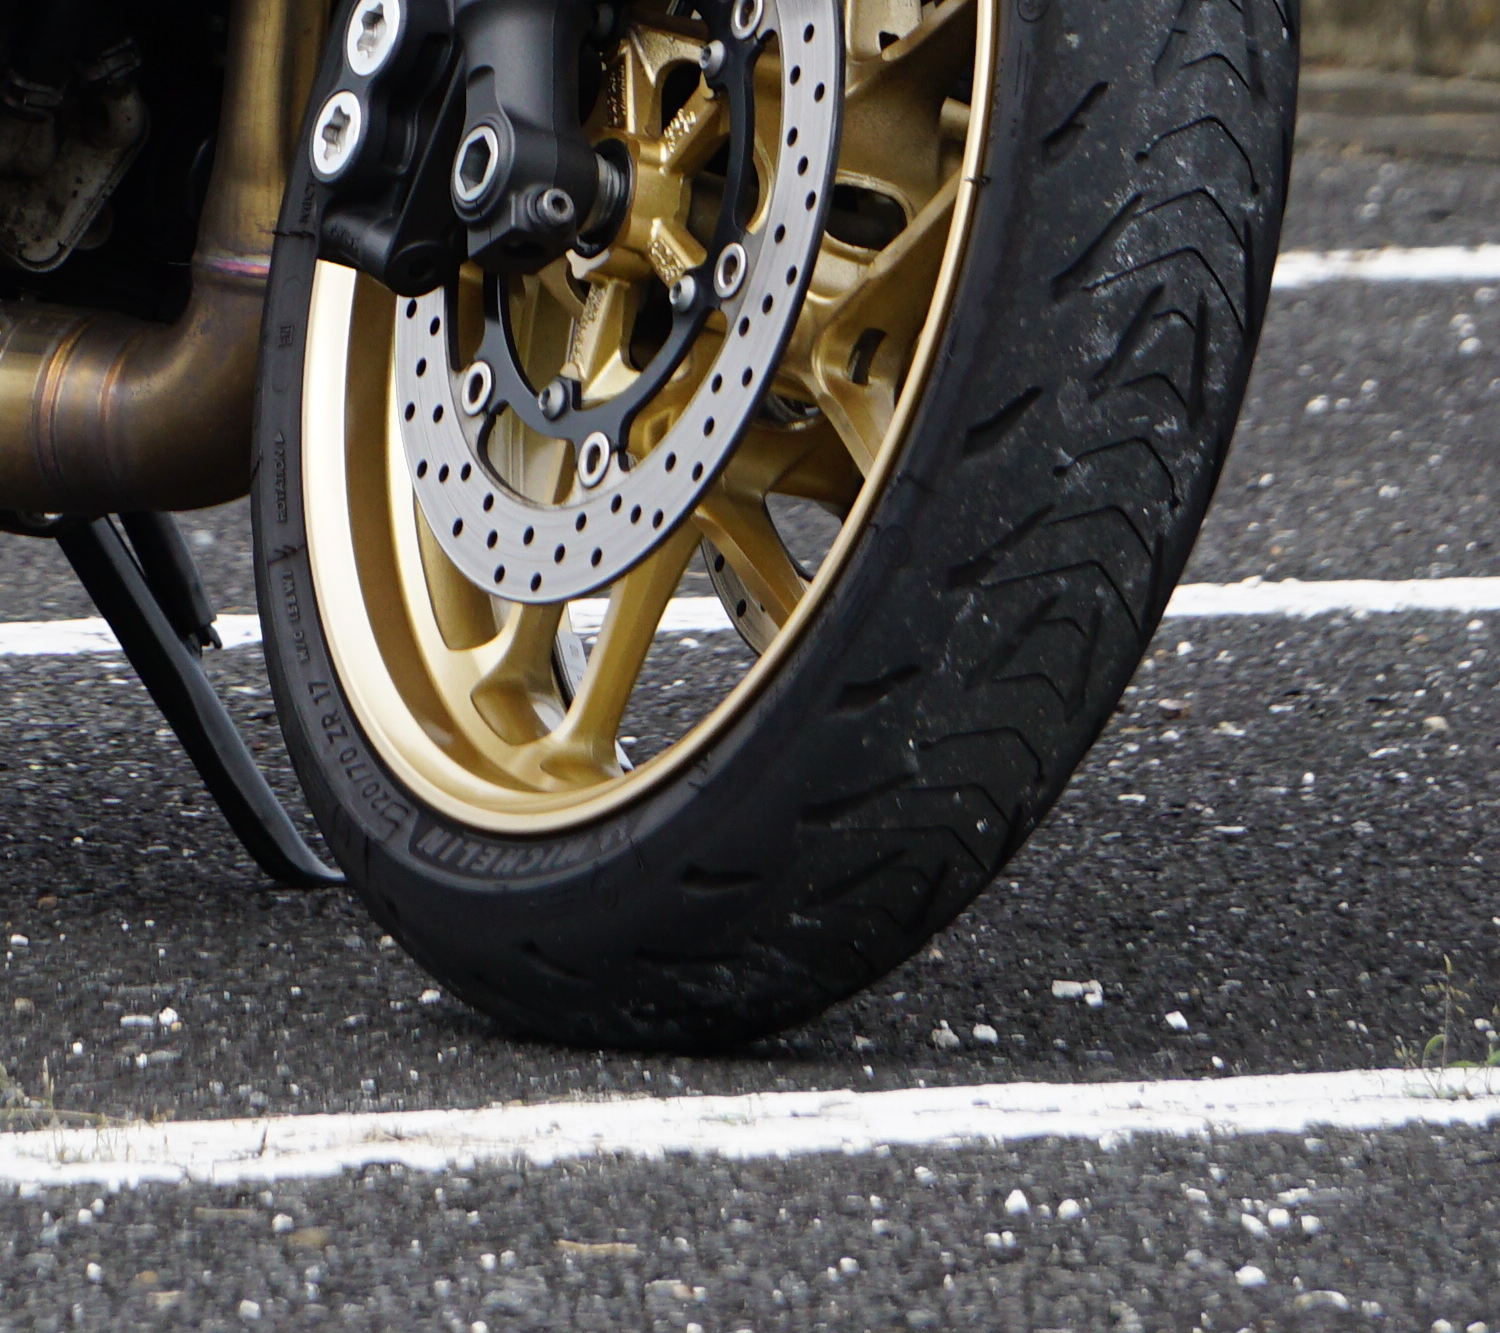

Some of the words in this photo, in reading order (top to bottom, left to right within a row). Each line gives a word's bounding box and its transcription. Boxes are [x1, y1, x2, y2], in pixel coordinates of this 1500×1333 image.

[307, 680, 331, 706] 17
[320, 710, 350, 745] ZR
[415, 825, 591, 875] MICHELIN
